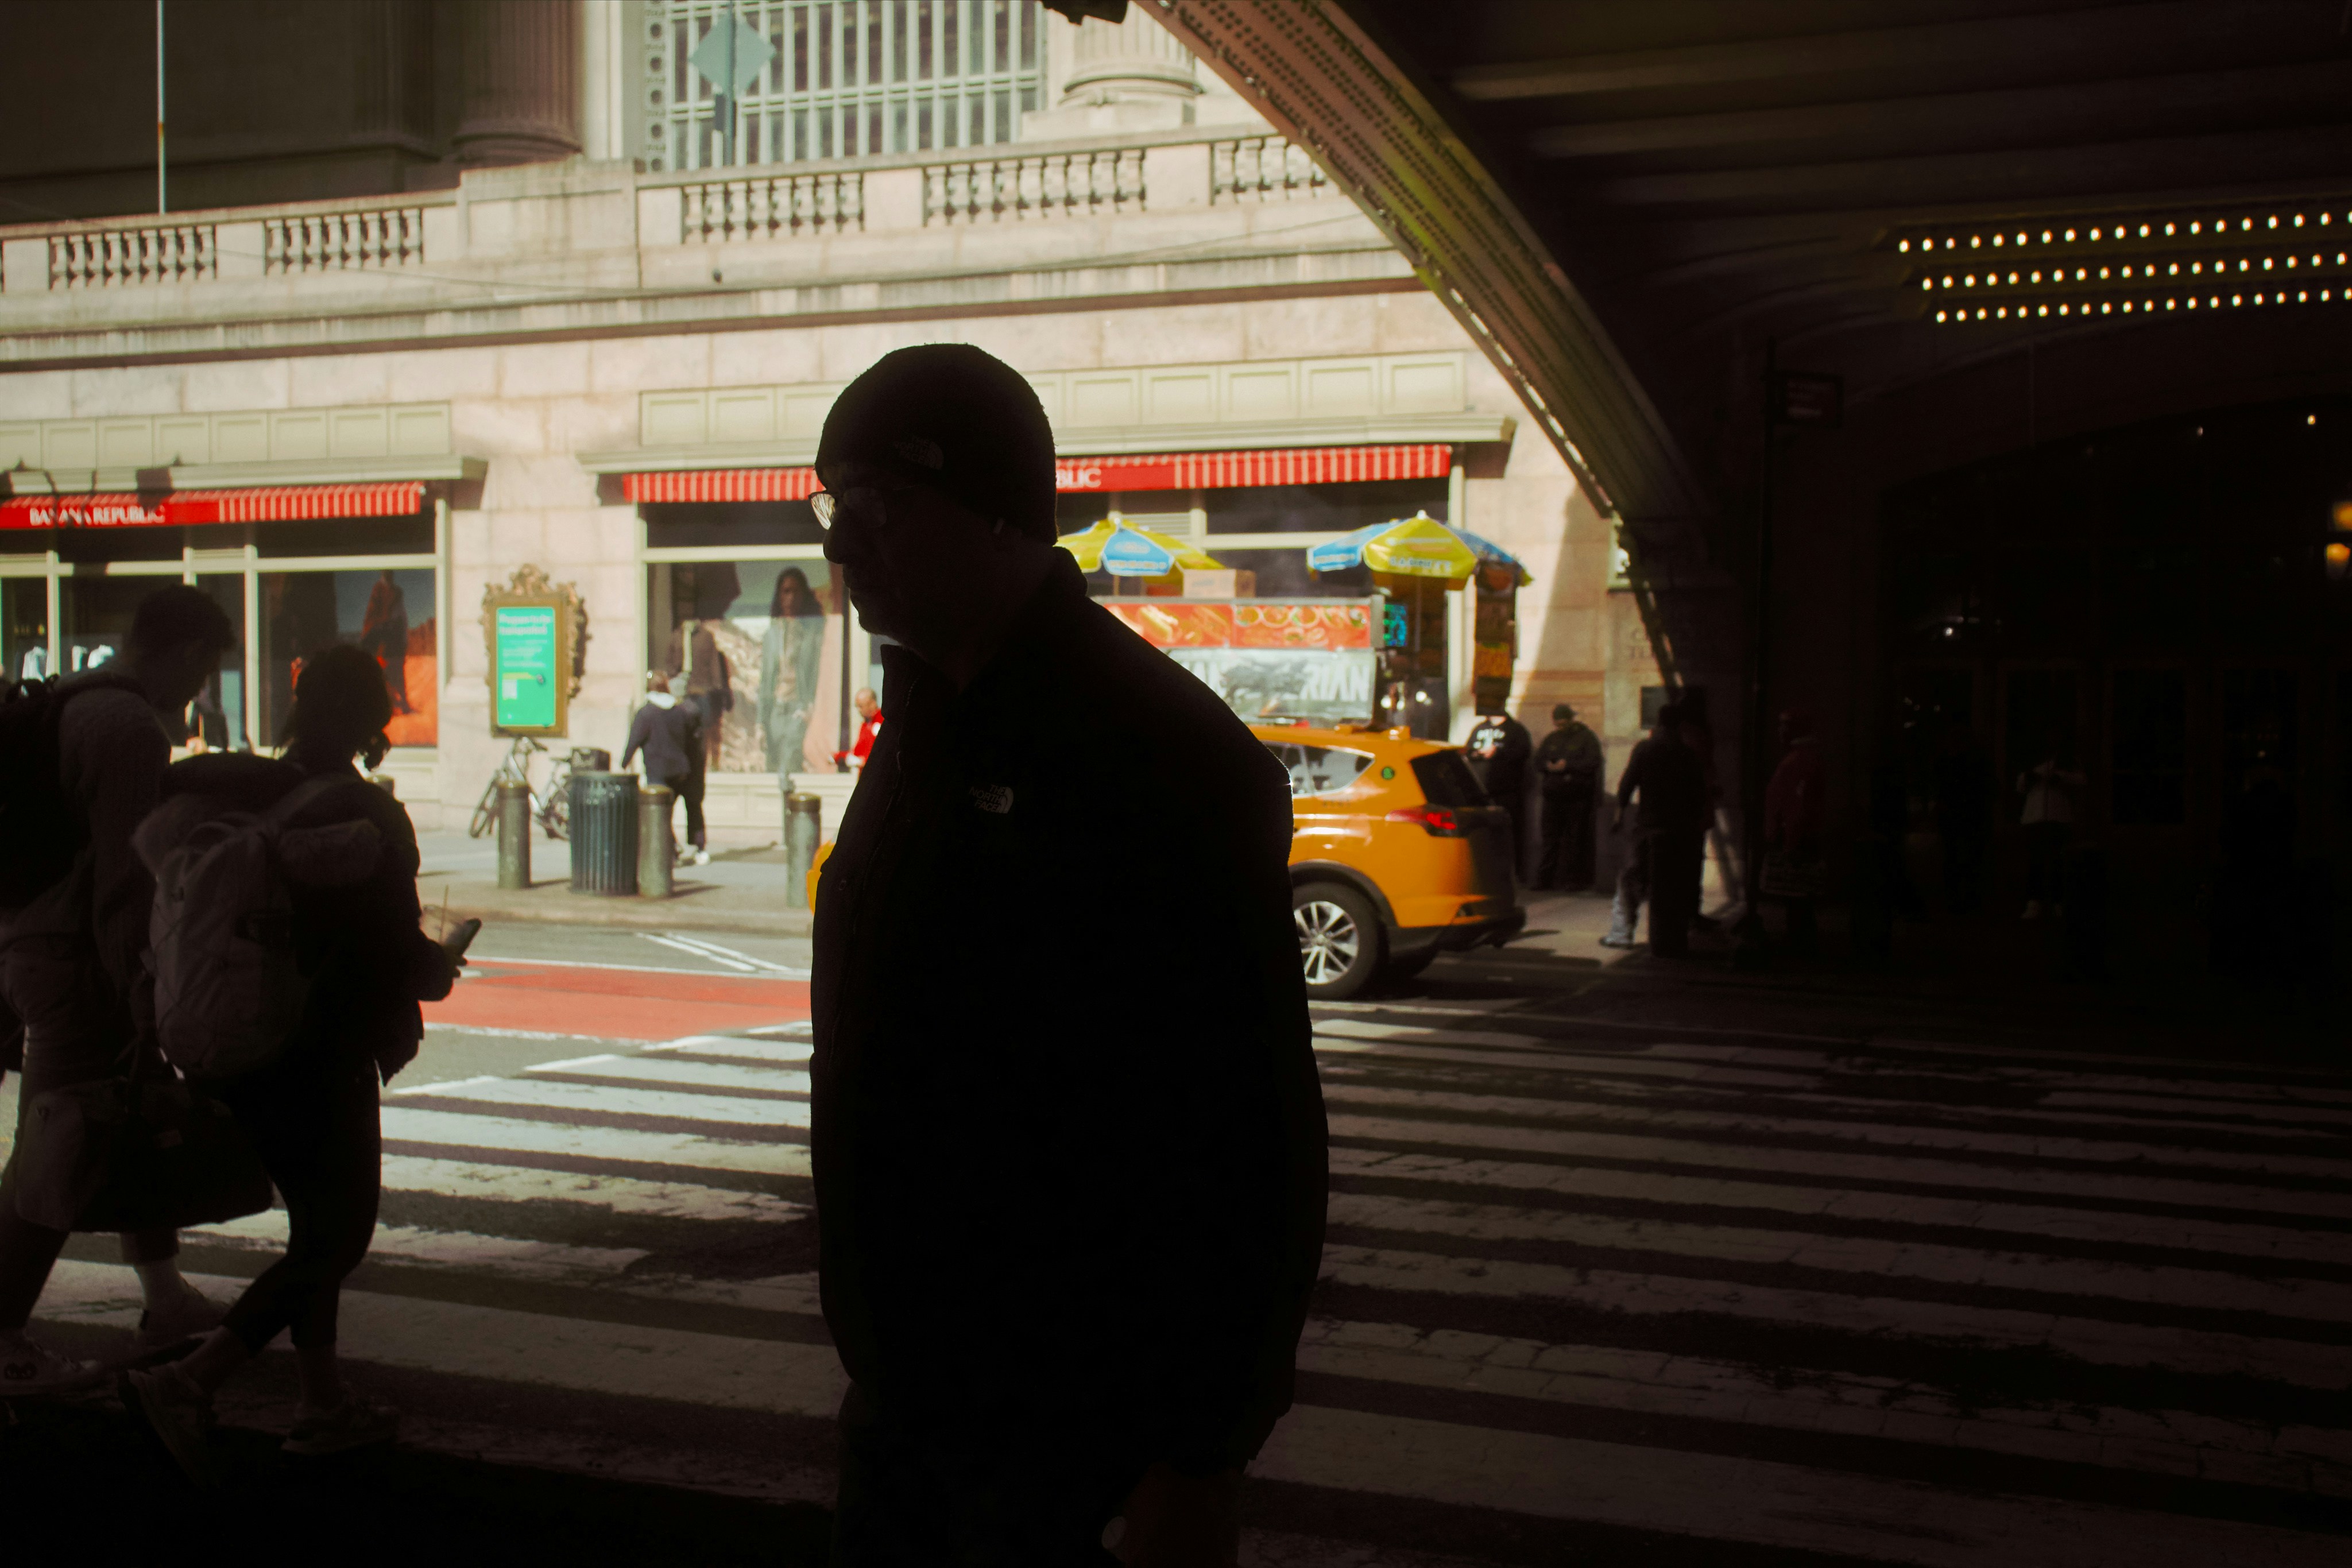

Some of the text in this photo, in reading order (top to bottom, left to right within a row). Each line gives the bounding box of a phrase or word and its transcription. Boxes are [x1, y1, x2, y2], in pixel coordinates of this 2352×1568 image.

[1055, 467, 1101, 488] BLIC
[969, 786, 1003, 804] NORTH
[989, 784, 1006, 796] THE
[974, 799, 998, 812] FACE
